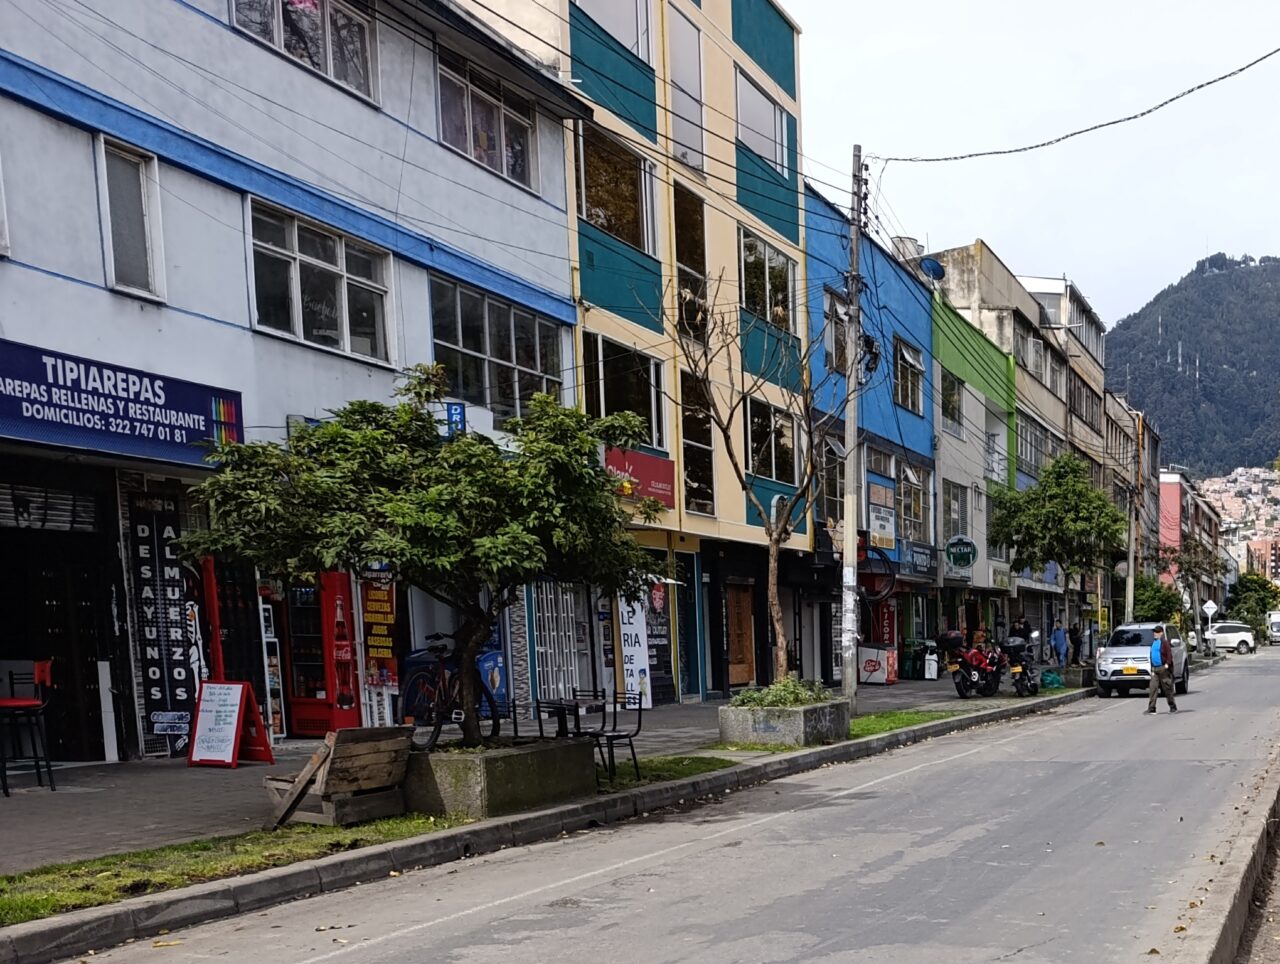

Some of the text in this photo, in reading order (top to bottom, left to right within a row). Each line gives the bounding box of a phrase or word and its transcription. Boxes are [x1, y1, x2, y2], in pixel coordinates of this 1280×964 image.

[42, 355, 166, 406] TIPIAREPAS
[0, 376, 206, 431] AREPAS RELLENAS Y RESTAURANTE
[22, 402, 187, 443] DOMICILIOS: 322 747 01 81
[950, 546, 972, 554] NECTAR
[137, 524, 162, 700] DESAYUNOS
[163, 526, 188, 700] ALMUERZOS
[623, 632, 641, 648] RIA
[624, 654, 635, 665] DE
[625, 668, 635, 678] TA
